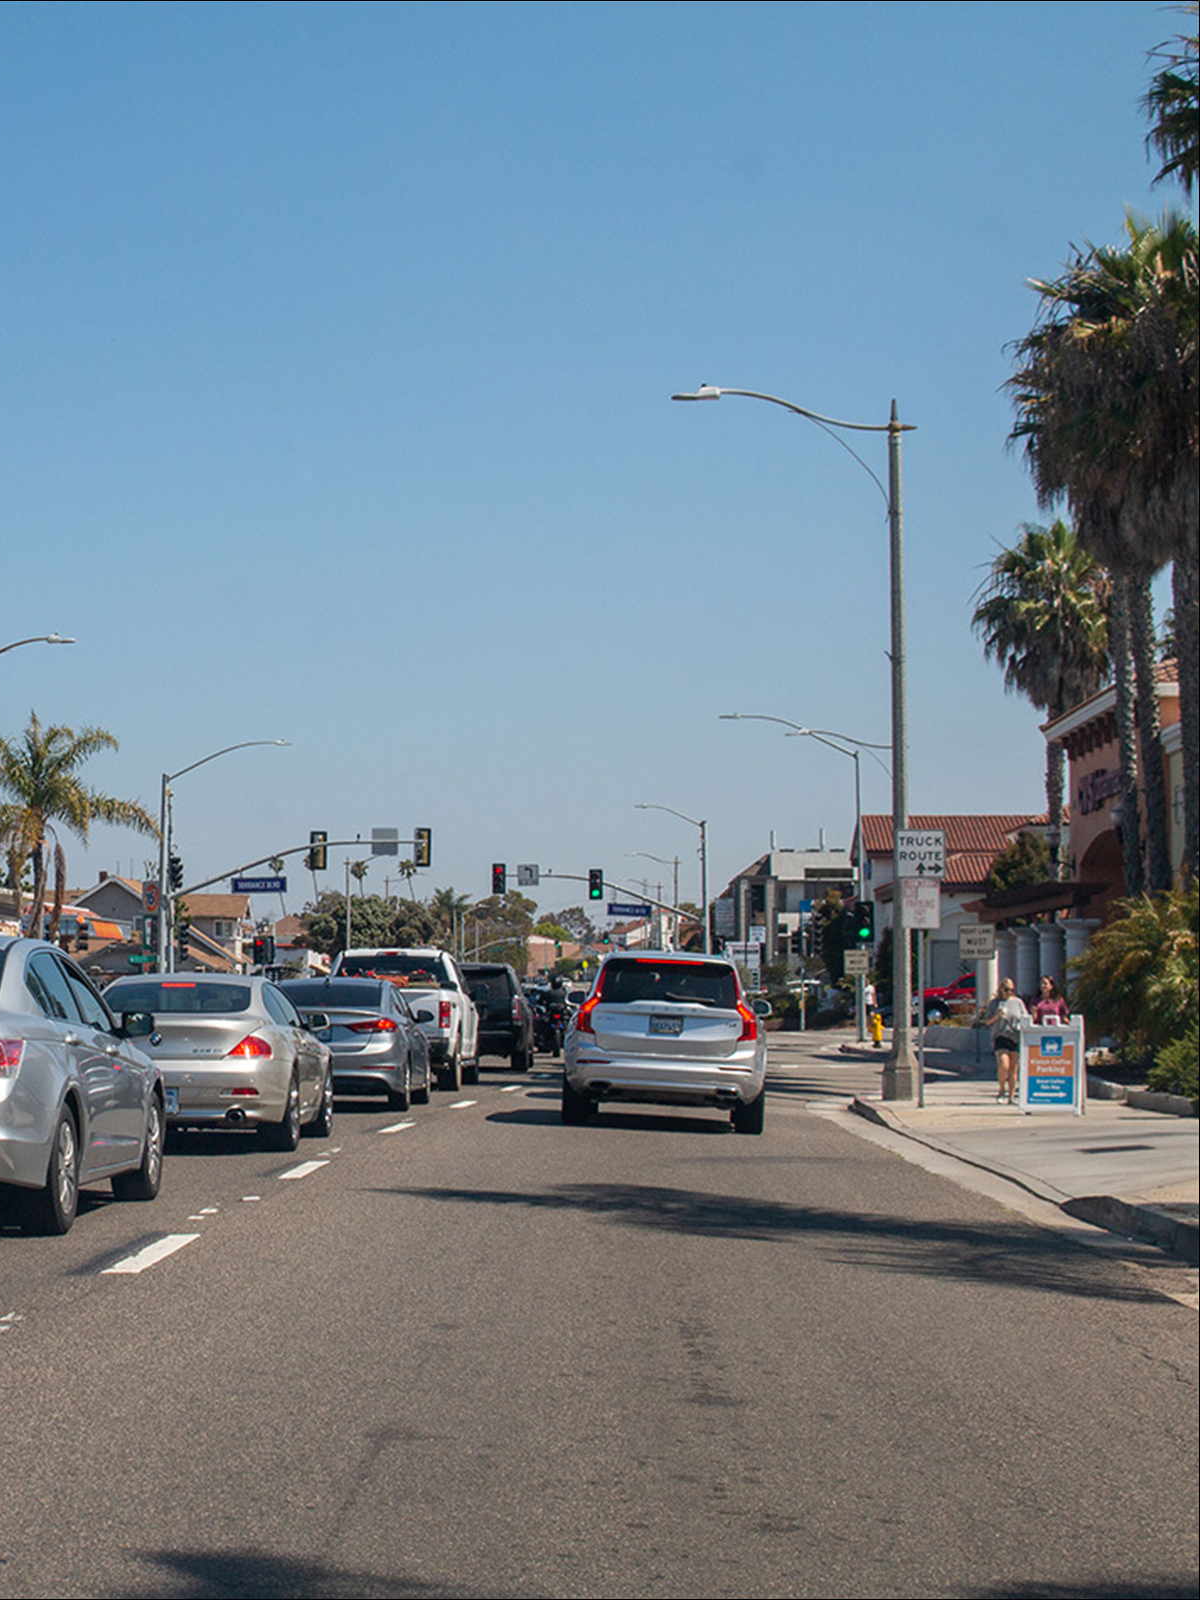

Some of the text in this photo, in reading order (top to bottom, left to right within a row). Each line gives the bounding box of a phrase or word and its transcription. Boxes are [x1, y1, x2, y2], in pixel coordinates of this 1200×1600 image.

[899, 836, 942, 846] TRUCK
[899, 851, 942, 861] ROUTE
[966, 938, 986, 946] MUST
[1036, 1066, 1065, 1074] Parking
